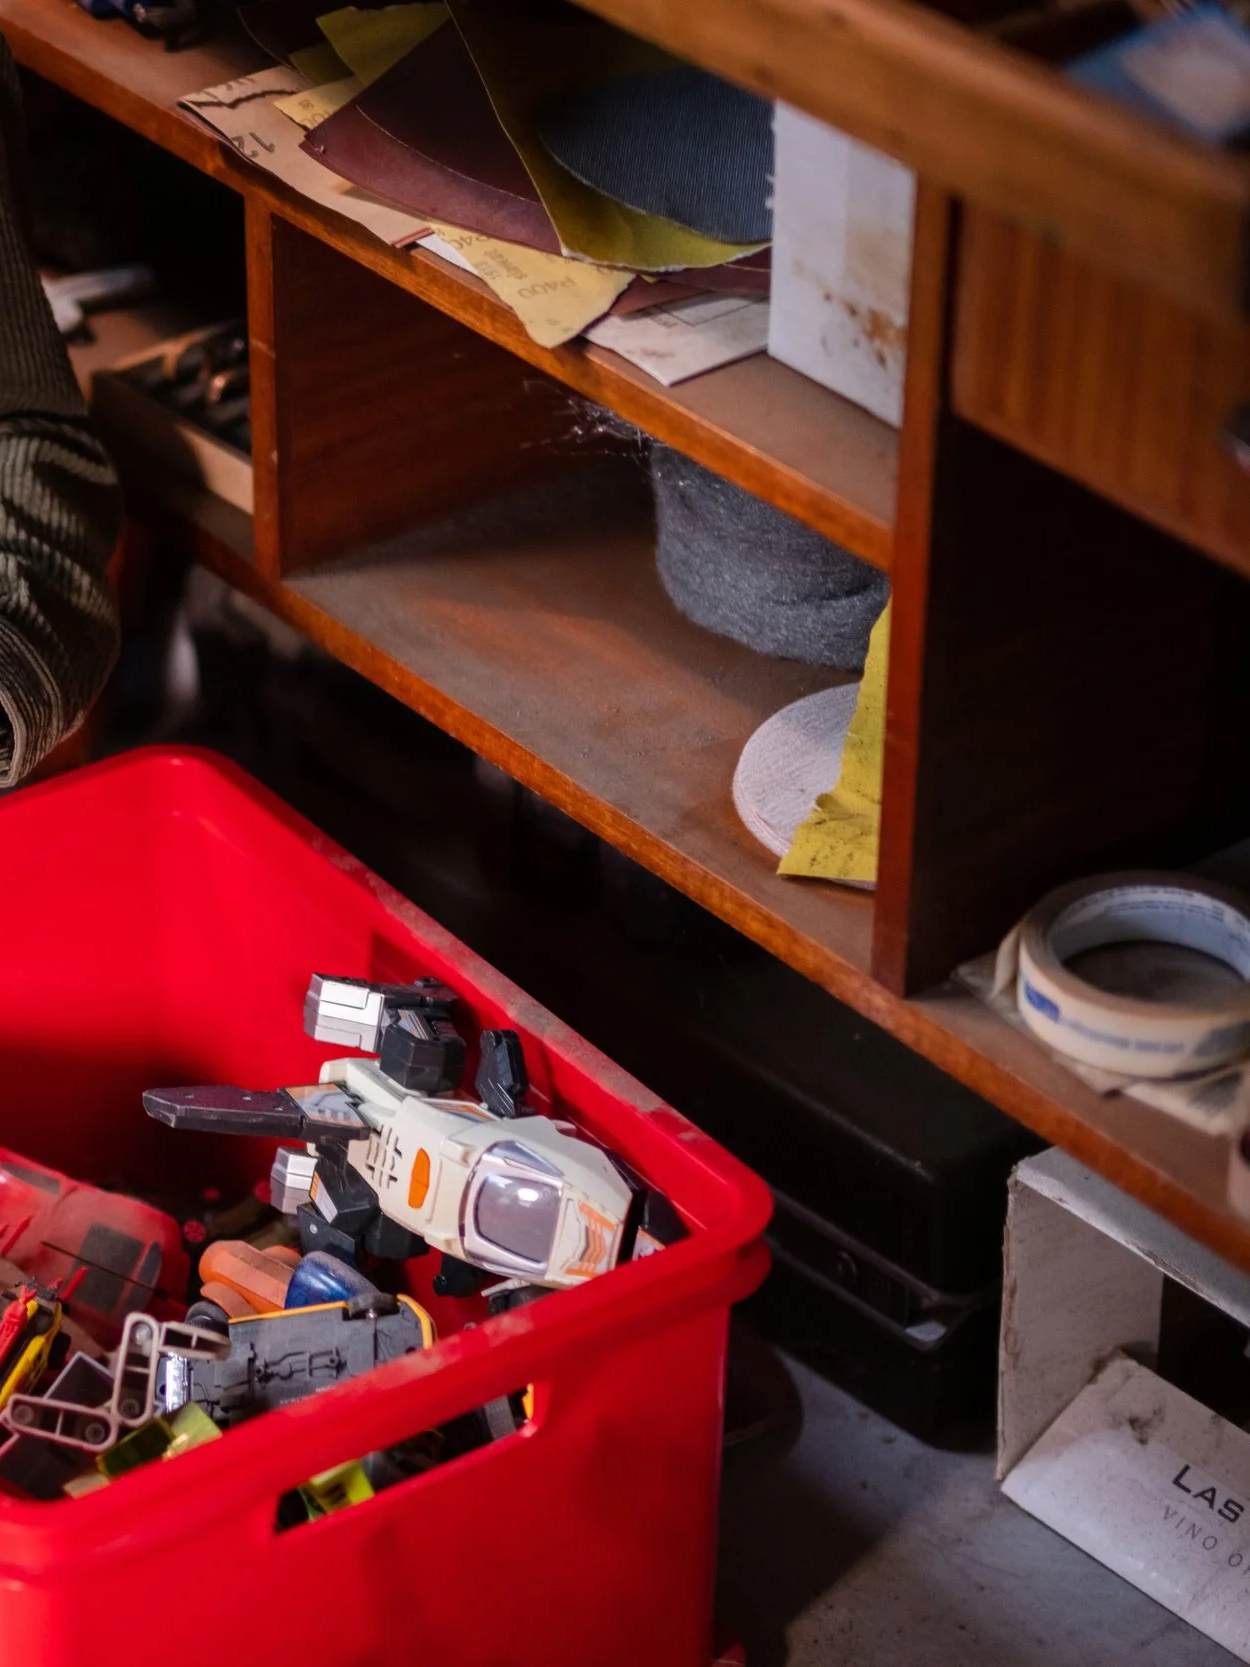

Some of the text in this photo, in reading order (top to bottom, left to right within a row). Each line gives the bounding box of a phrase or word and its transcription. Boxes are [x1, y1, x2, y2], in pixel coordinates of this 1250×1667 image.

[517, 276, 578, 299] P400
[1172, 1464, 1245, 1524] LAS
[1163, 1505, 1218, 1551] VINO
